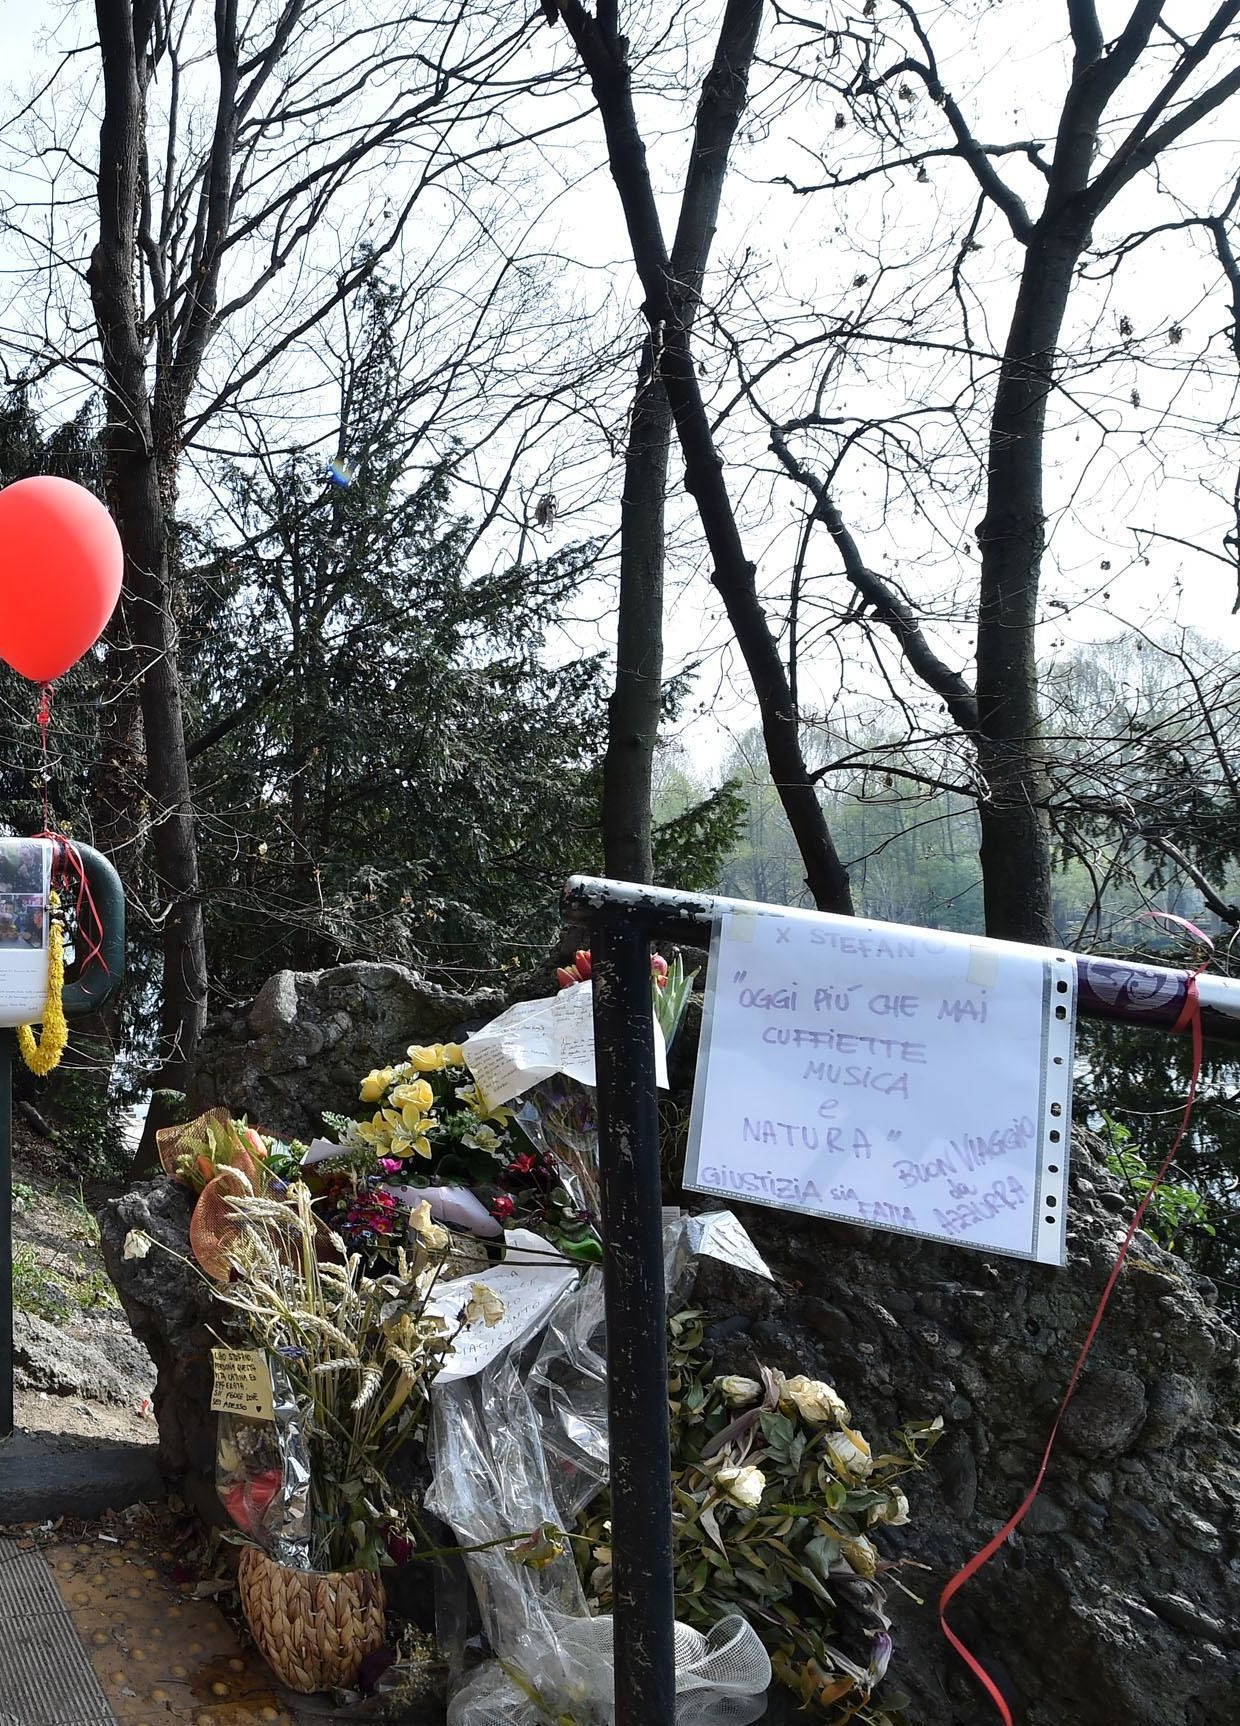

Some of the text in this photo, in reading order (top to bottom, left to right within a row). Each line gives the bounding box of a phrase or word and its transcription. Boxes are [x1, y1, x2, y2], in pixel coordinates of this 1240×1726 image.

[775, 926, 947, 959] X STEFANO
[868, 993, 920, 1018] CHE
[937, 990, 988, 1024] MAI
[761, 1026, 927, 1064] CUFFIETTE
[803, 1060, 909, 1099] MUSICA
[893, 1115, 1036, 1189] BUON VIAGGIO
[701, 1165, 822, 1204] GIUSTIZIA
[947, 1178, 978, 1201] da
